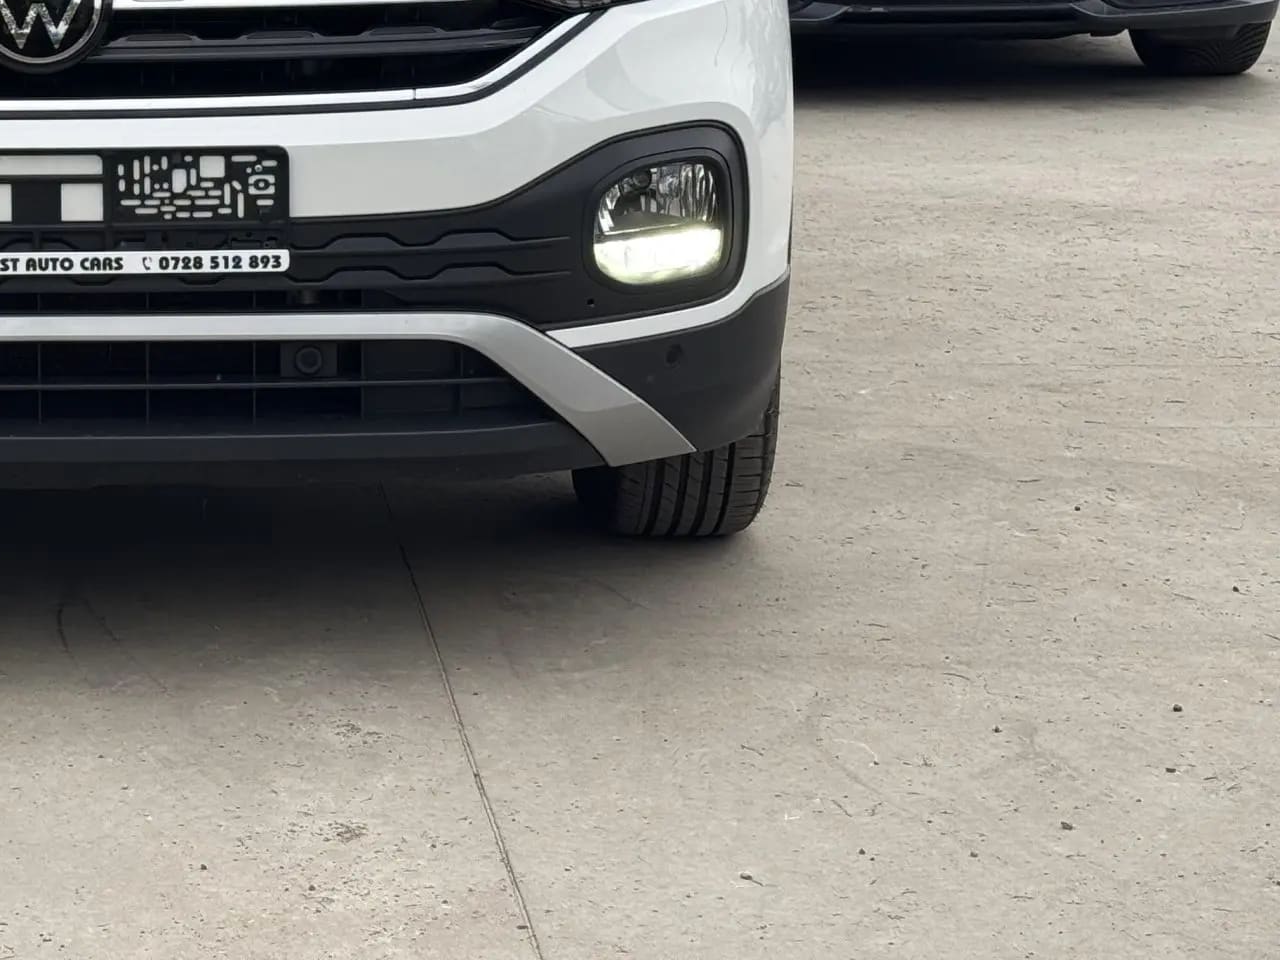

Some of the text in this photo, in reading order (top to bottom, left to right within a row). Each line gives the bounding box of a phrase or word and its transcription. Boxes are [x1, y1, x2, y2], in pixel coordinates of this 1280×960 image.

[25, 257, 74, 272] AUTO
[80, 256, 124, 272] CARS
[158, 256, 204, 271] 0728
[210, 255, 243, 270] 512
[248, 254, 282, 270] 893
